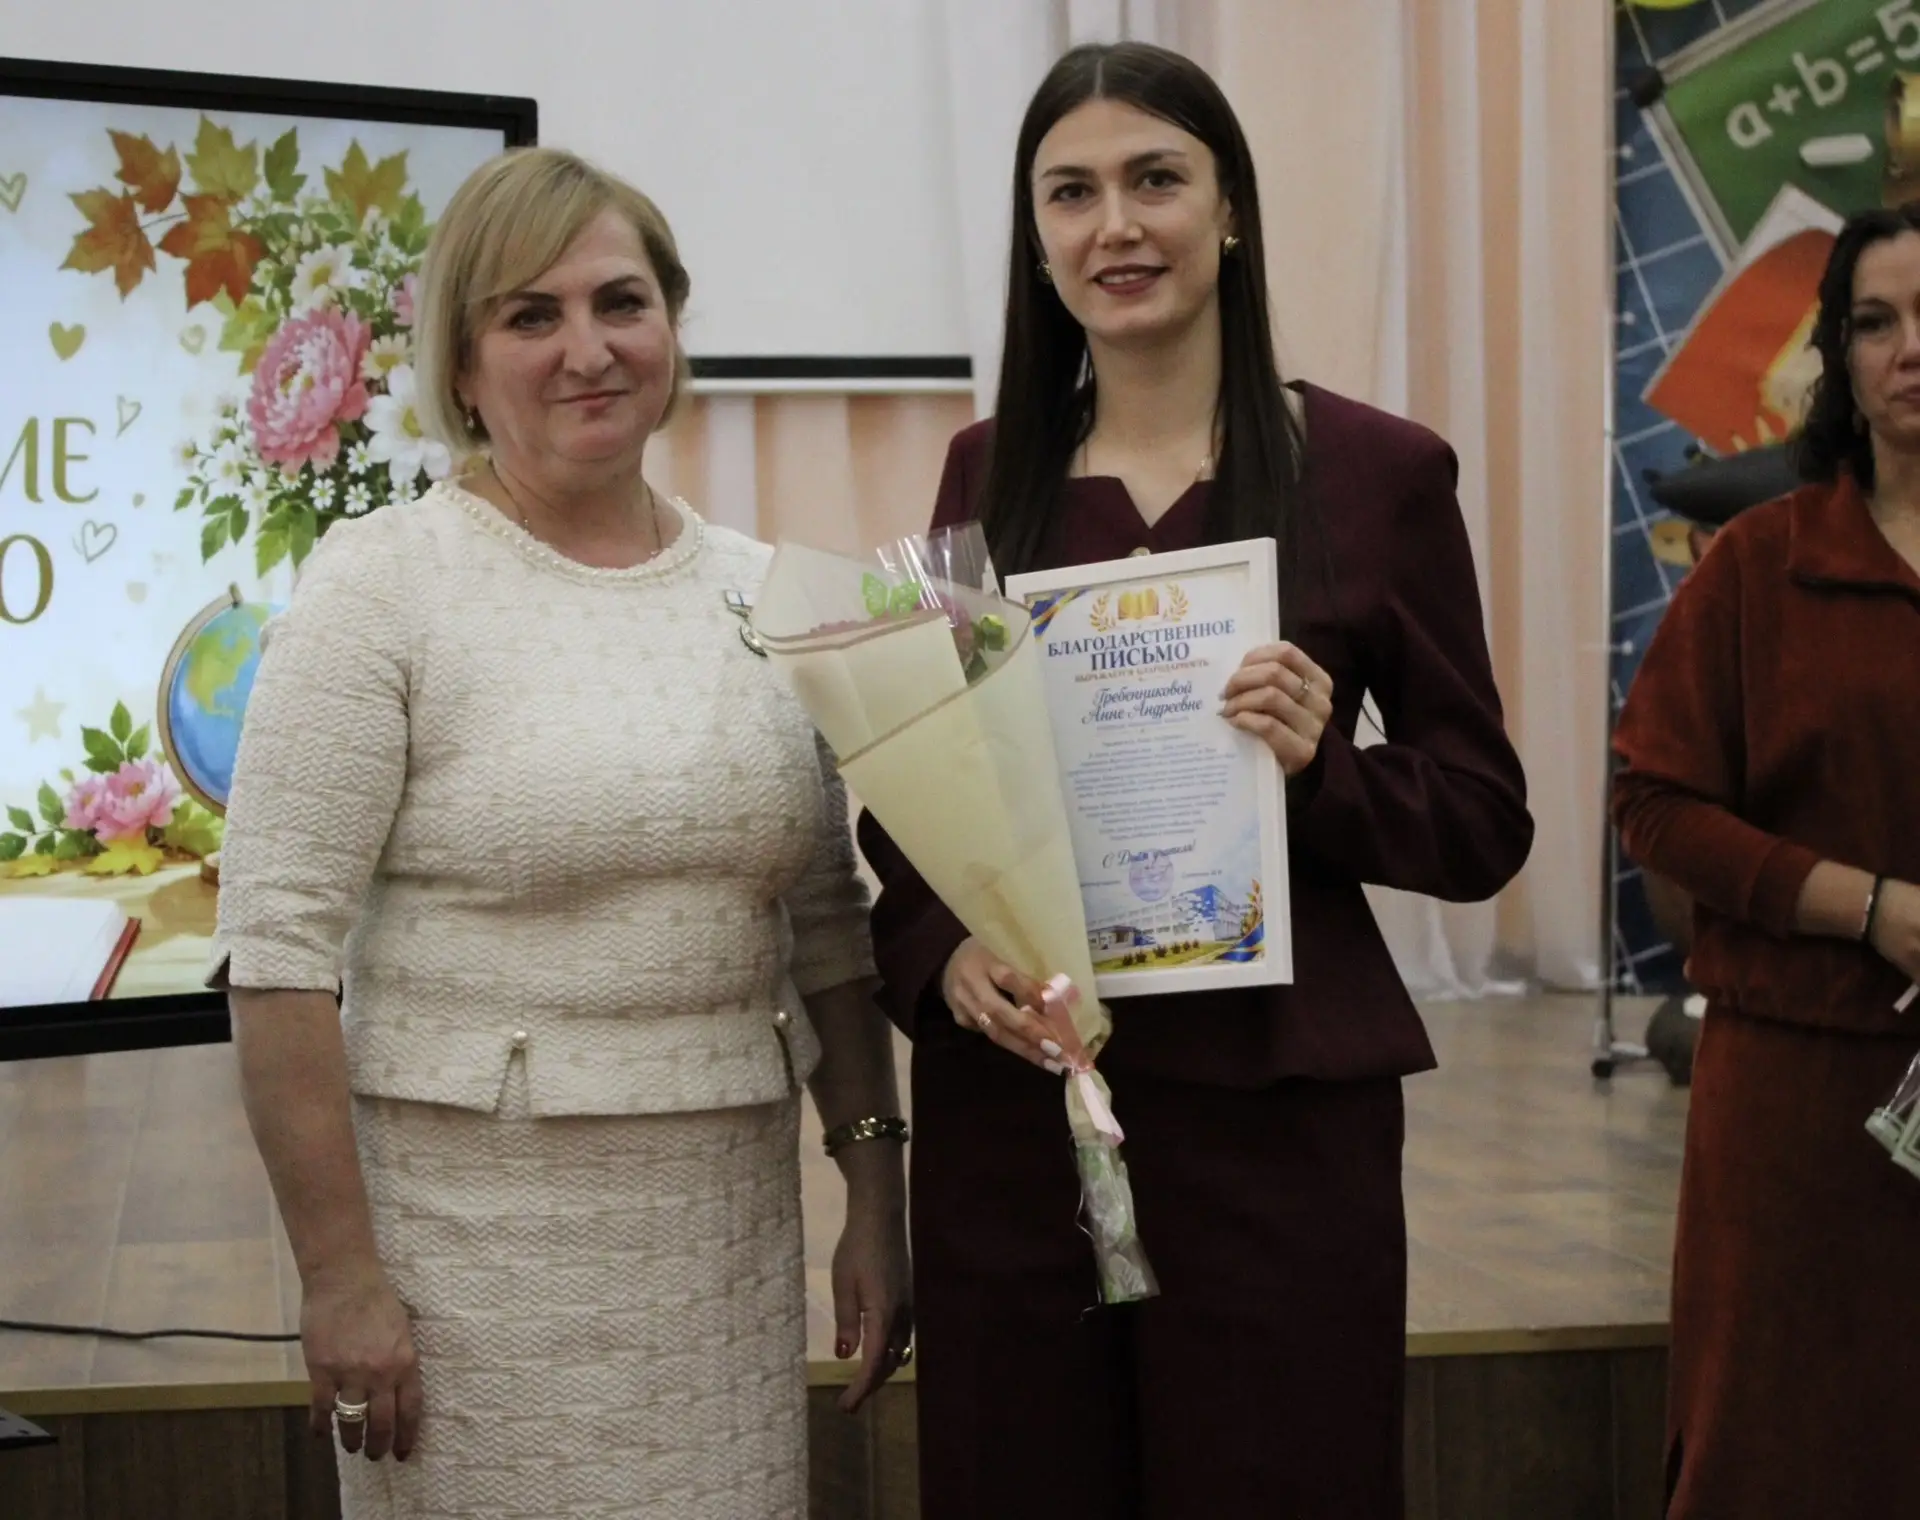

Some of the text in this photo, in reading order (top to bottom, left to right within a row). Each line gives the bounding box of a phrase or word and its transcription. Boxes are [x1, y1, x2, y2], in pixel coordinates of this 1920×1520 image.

[1726, 0, 1920, 148] a+b=5
[1048, 619, 1235, 657] БЛАГОДАРСТВЕННОЕ
[1091, 642, 1190, 671] ПИСЬМО
[1081, 703, 1125, 725] Анне
[1127, 695, 1203, 719] Андреевне
